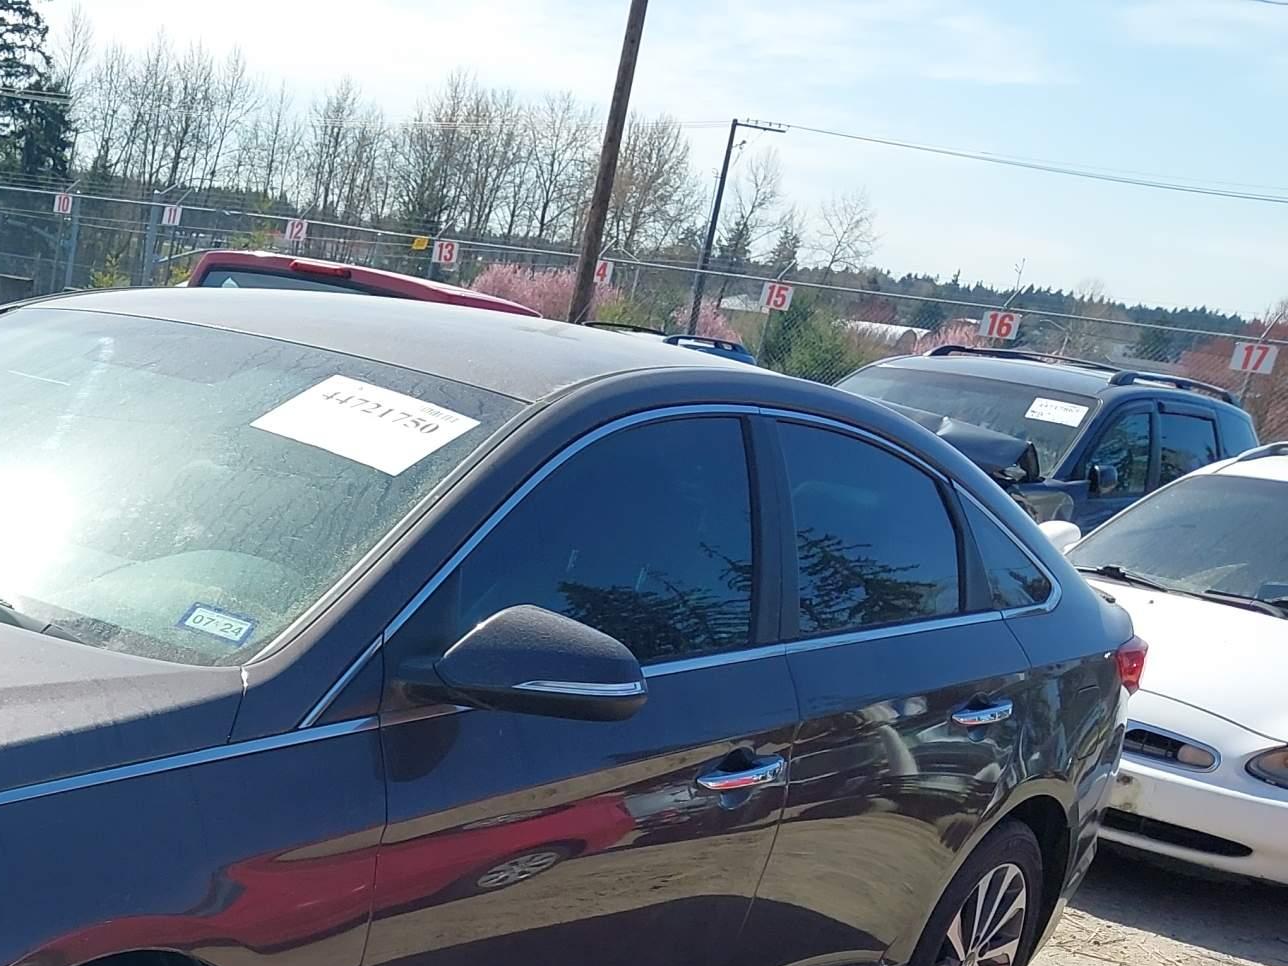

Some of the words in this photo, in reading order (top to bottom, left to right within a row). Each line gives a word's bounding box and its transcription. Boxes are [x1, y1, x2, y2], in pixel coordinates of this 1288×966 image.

[57, 196, 71, 211] 10
[167, 208, 178, 223] 11
[290, 223, 304, 239] 12
[437, 242, 456, 263] 13
[766, 283, 788, 308] 15
[988, 313, 1014, 338] 16
[1242, 344, 1270, 369] 17
[322, 391, 440, 434] 44721750
